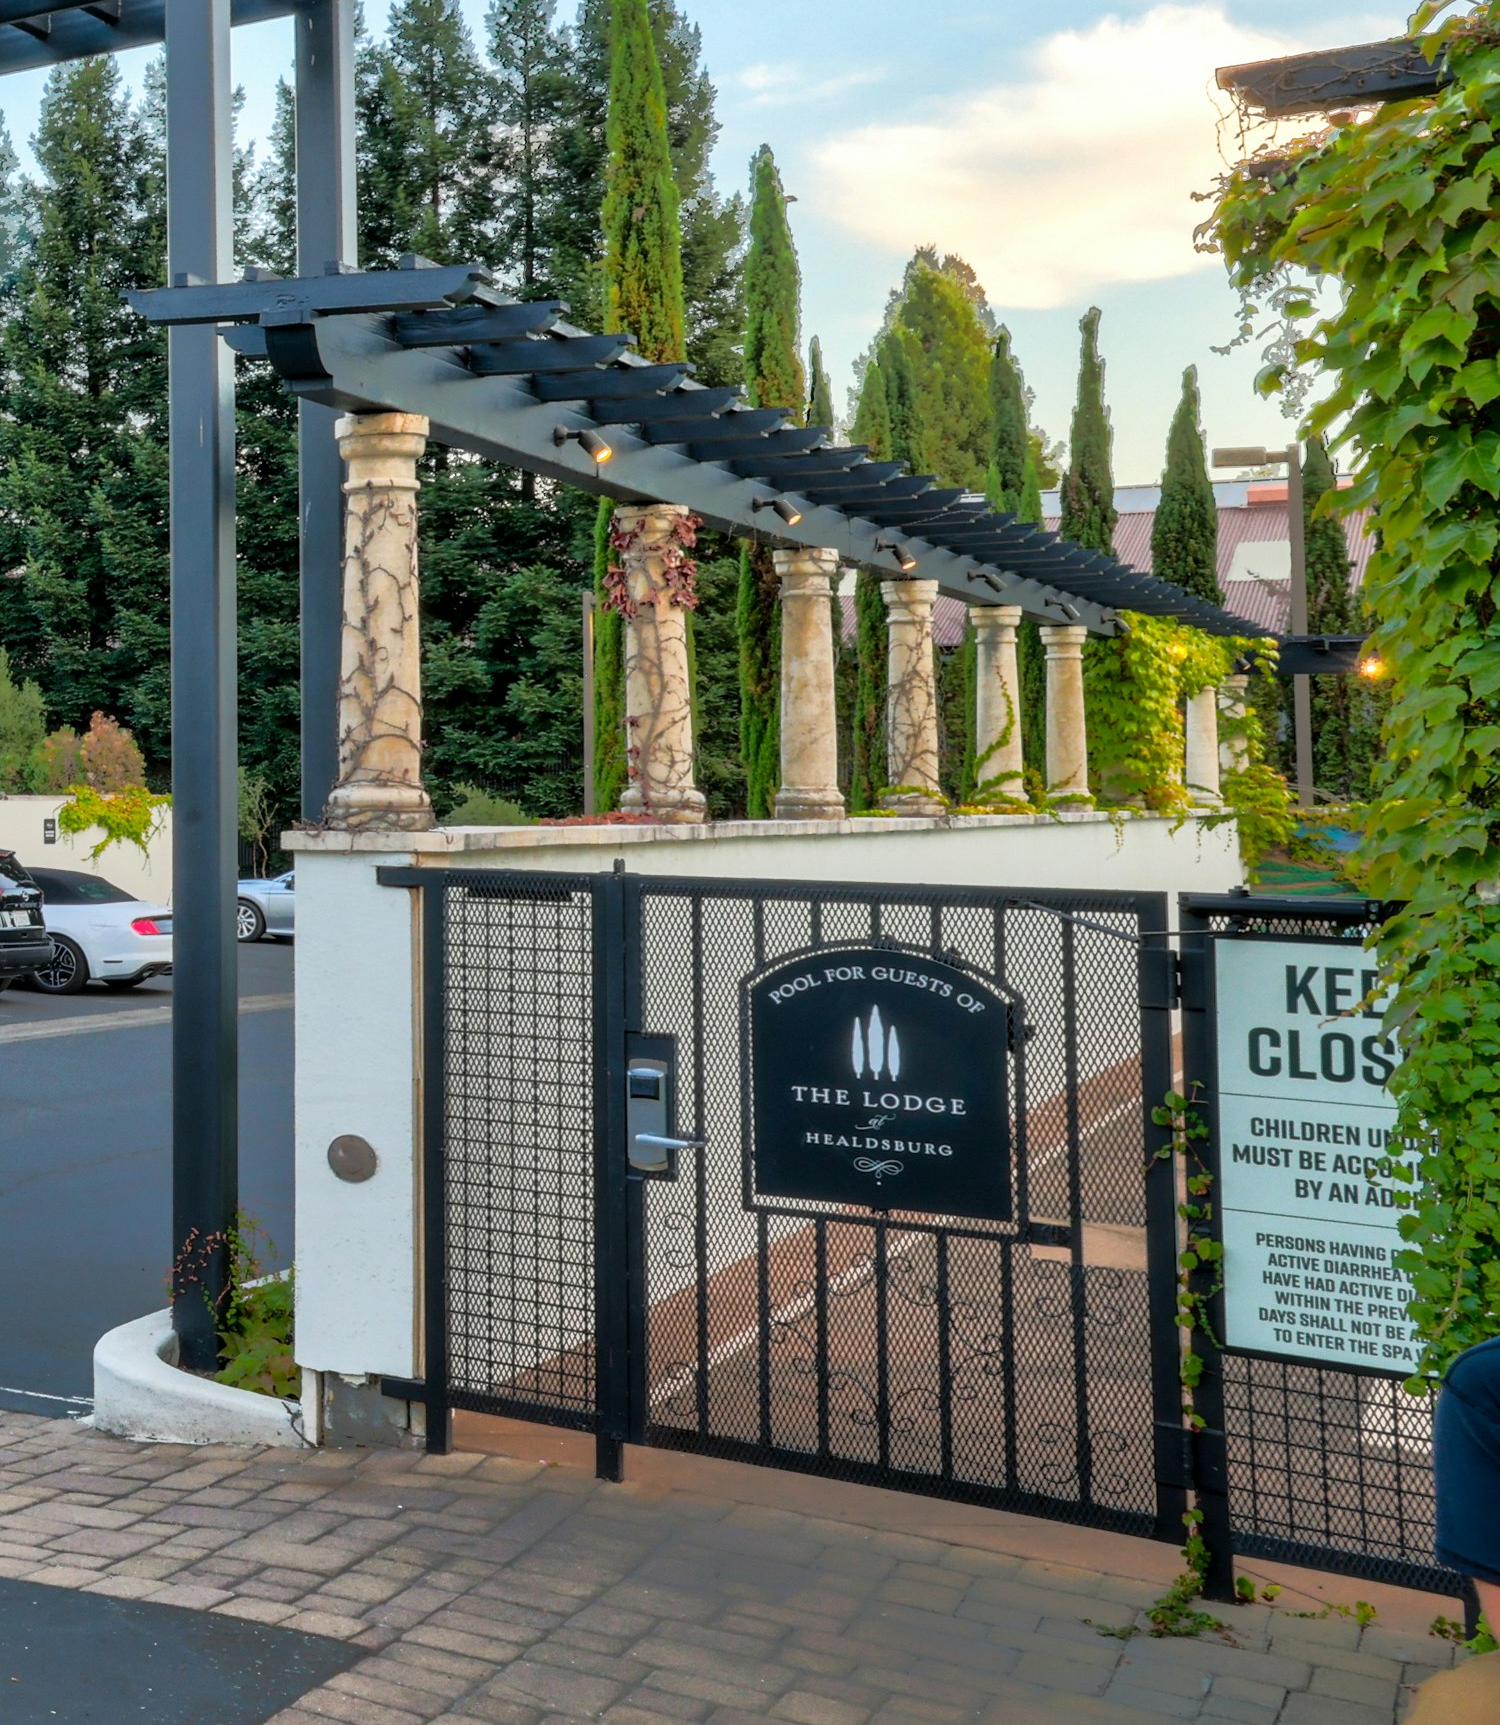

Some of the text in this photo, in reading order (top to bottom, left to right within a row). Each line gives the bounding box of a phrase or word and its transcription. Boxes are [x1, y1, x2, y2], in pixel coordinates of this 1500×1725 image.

[768, 966, 986, 1014] POOL FOR GUESTS OF
[1285, 964, 1389, 1020] KEE
[1248, 1027, 1404, 1087] CLOS
[791, 1085, 967, 1116] THE LODGE
[855, 1113, 897, 1131] at
[1250, 1116, 1361, 1147] CHILDREN
[805, 1132, 954, 1157] HEALDSBURG
[1232, 1143, 1293, 1168] MUST
[1298, 1150, 1327, 1172] BE
[1295, 1178, 1323, 1200] BY
[1328, 1182, 1359, 1204] AN
[1256, 1232, 1326, 1254] PERSONS
[1329, 1241, 1387, 1261] HAVING
[1268, 1252, 1320, 1272] ACTIVE
[1324, 1259, 1402, 1283] DIARRHEA
[1262, 1270, 1300, 1288] HAVE
[1304, 1276, 1335, 1293] HAD
[1339, 1280, 1393, 1301] ACTIVE
[1275, 1291, 1413, 1323] WITHIN THE PREV
[1259, 1307, 1296, 1325] DAYS
[1300, 1313, 1348, 1333] SHALL
[1351, 1320, 1382, 1337] NOT
[1385, 1325, 1406, 1341] BE
[1273, 1327, 1292, 1343] TO
[1296, 1332, 1345, 1351] ENTER
[1348, 1338, 1379, 1356] THE
[1381, 1343, 1413, 1361] SPA
